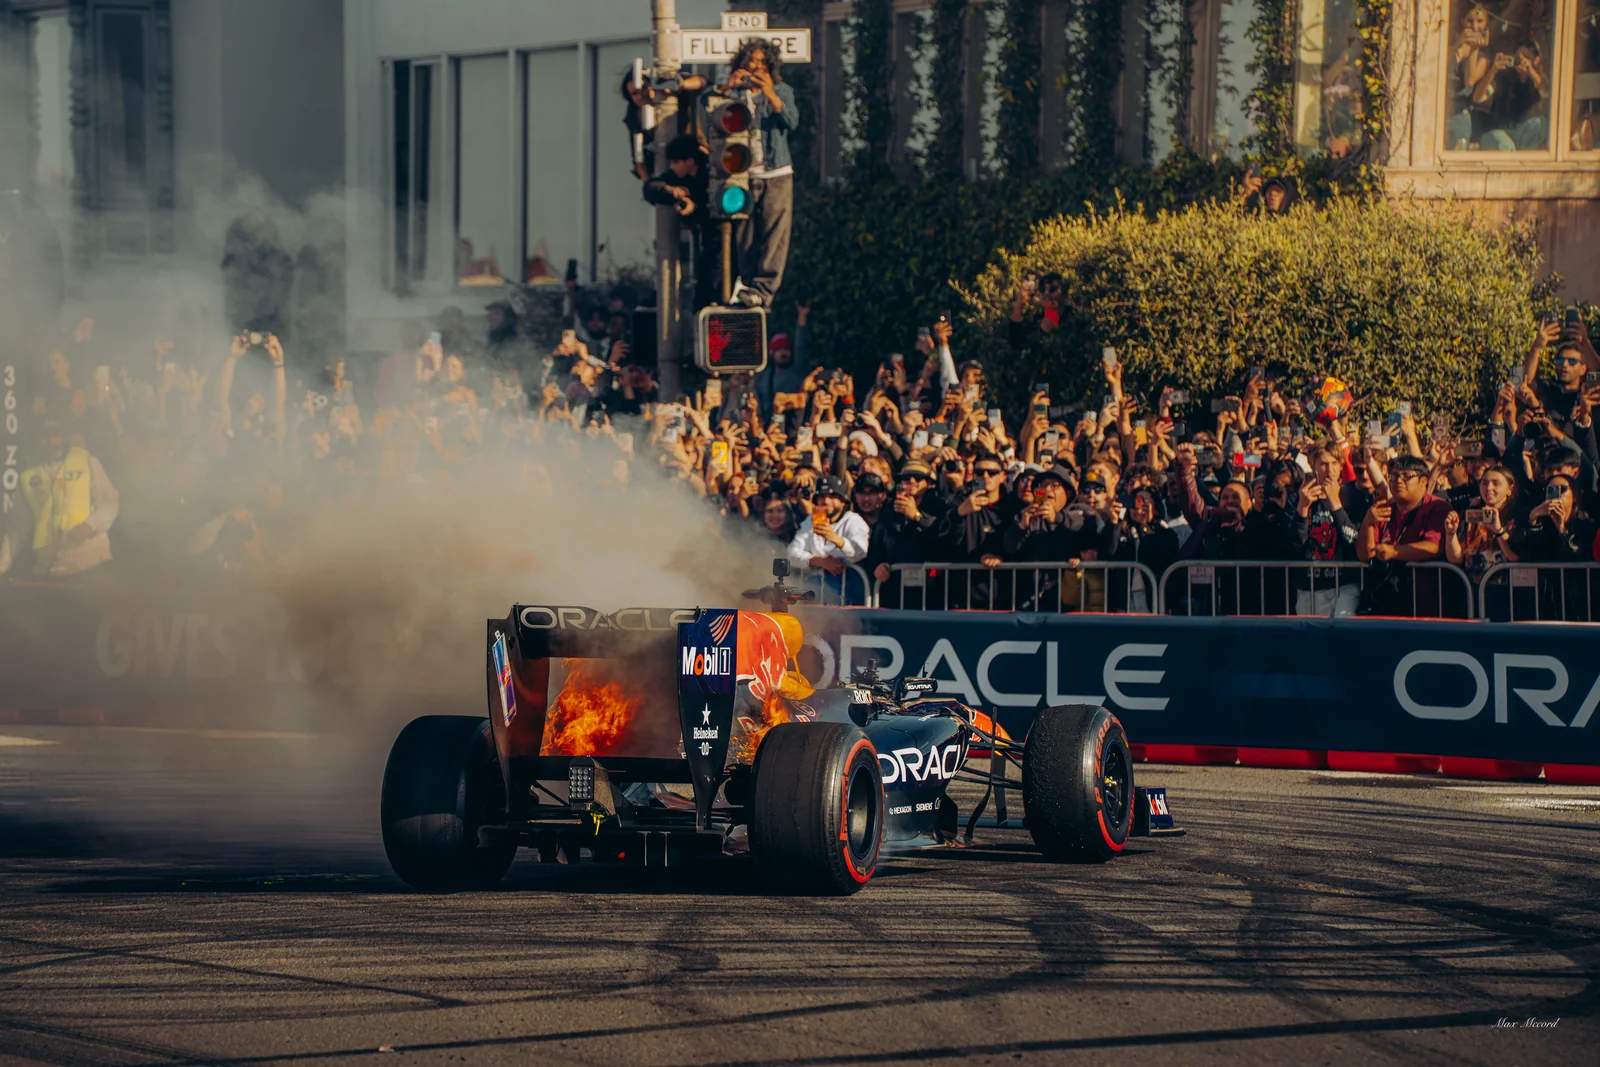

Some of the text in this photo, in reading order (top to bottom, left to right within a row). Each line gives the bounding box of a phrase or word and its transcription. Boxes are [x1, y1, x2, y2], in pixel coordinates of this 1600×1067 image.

[728, 15, 761, 27] END
[691, 37, 797, 55] FILLRE
[683, 646, 718, 676] Mobil
[693, 726, 719, 739] Heineken
[893, 805, 912, 815] HEXAGON
[915, 802, 933, 812] SIEMENS
